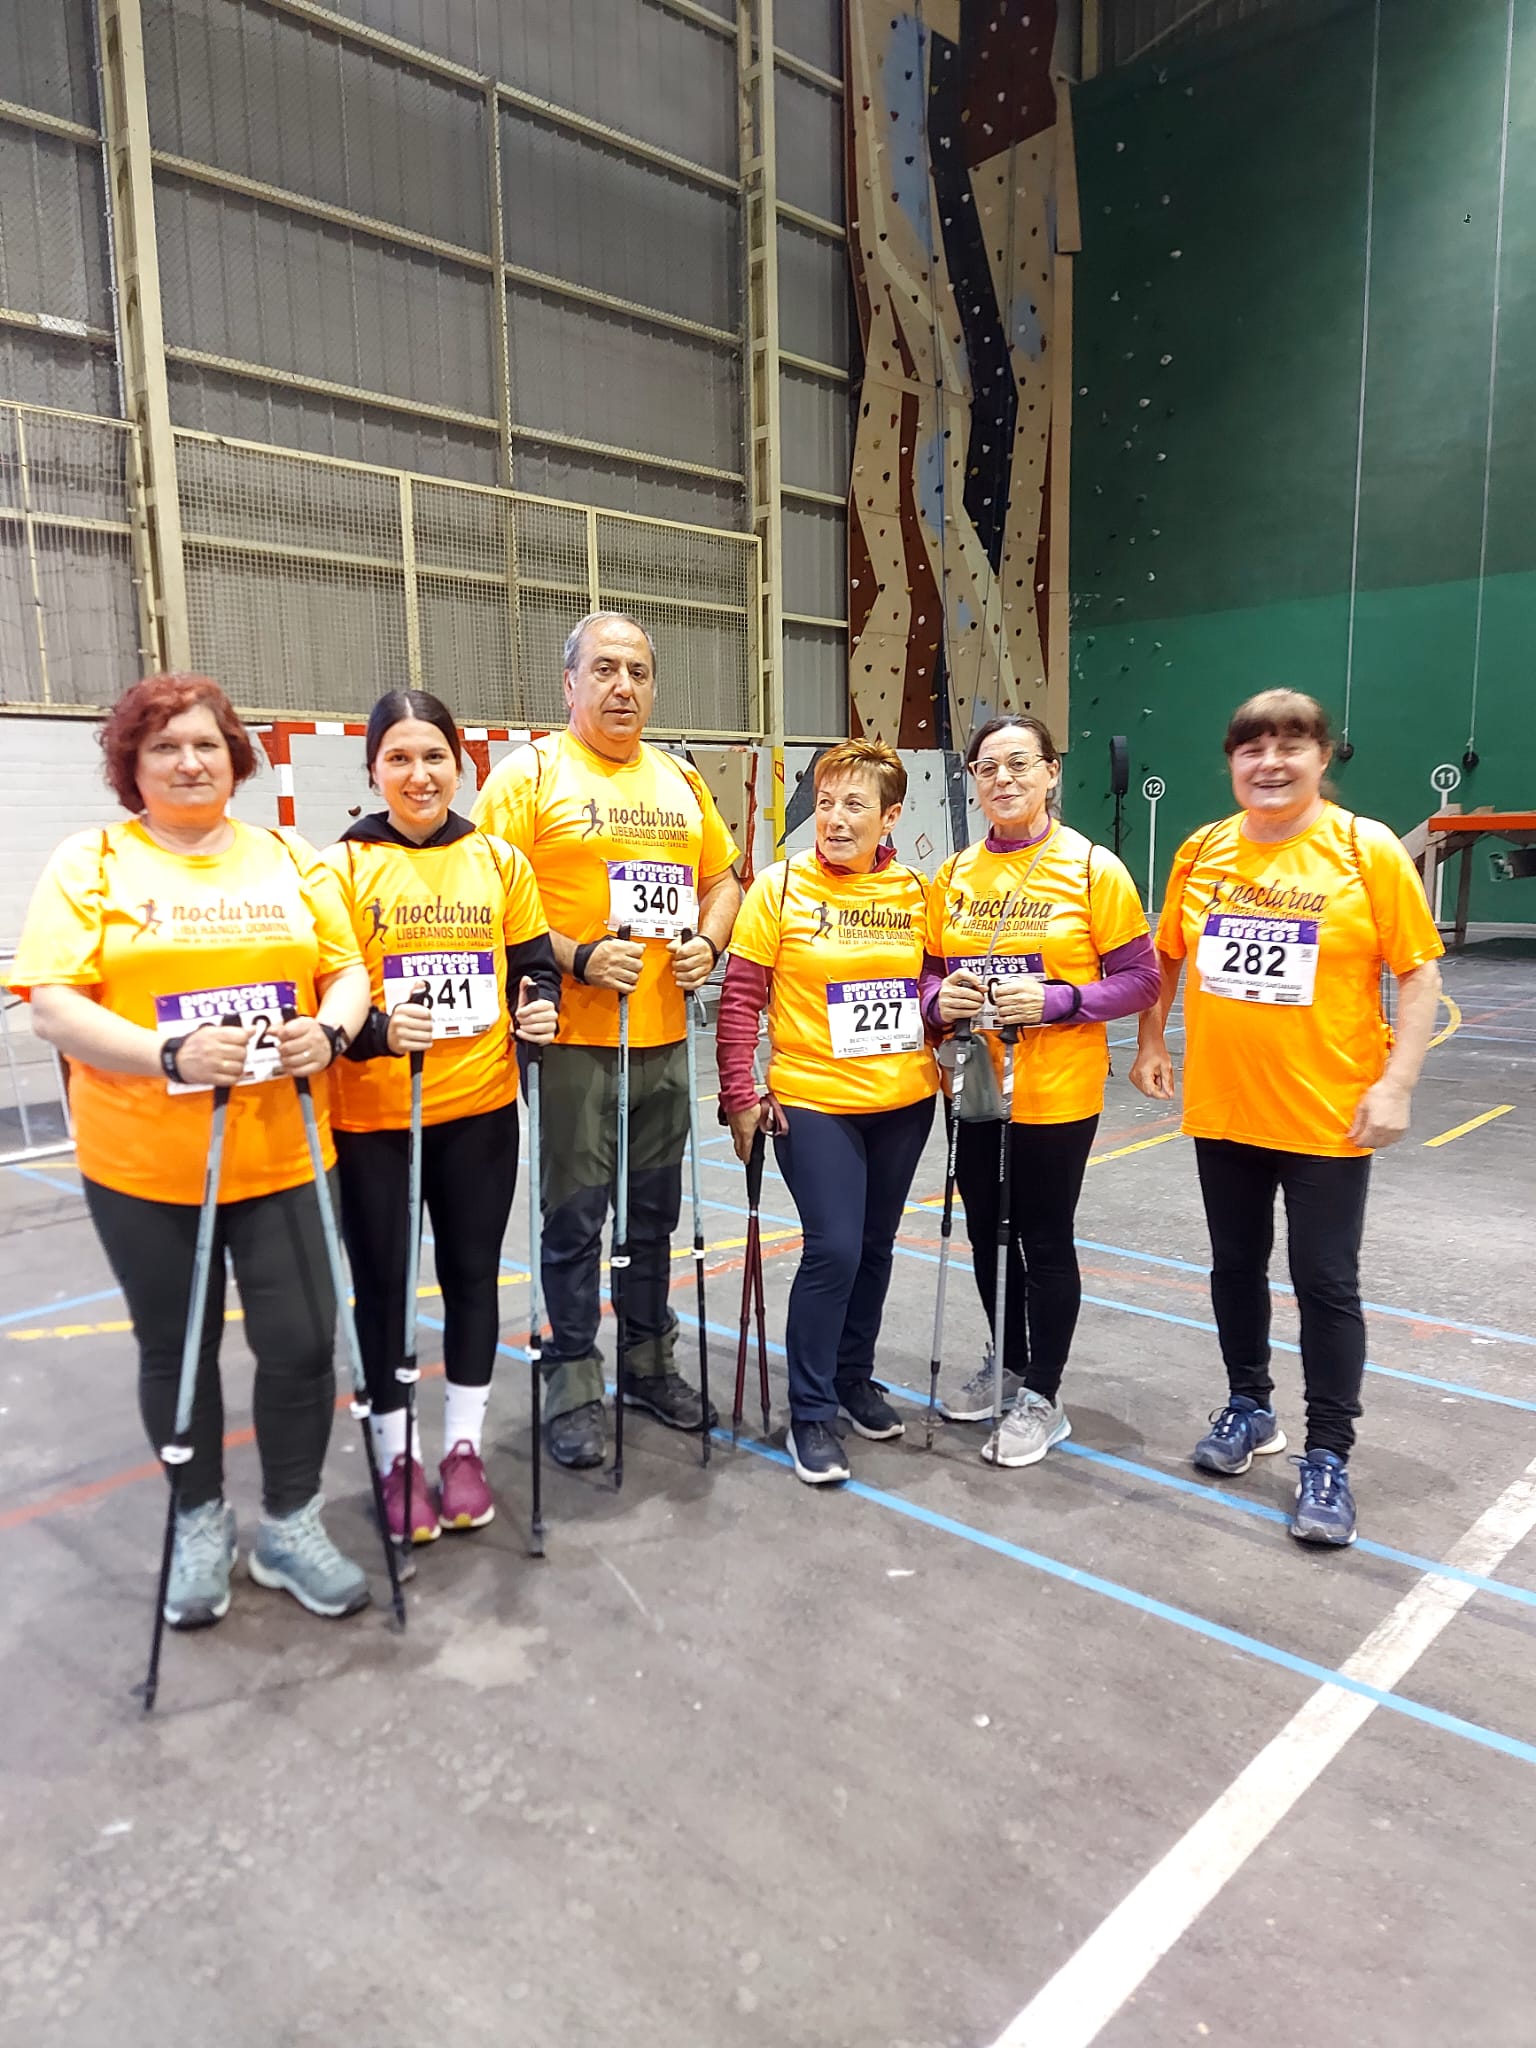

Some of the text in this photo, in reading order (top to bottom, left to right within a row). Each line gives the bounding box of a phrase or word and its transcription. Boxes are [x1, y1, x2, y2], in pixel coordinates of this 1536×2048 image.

[1436, 771, 1454, 786] 11
[1146, 782, 1161, 795] 12
[609, 801, 687, 828] nocturna
[610, 826, 689, 842] LIBERANOS DOMINE
[624, 863, 684, 876] DIPUTACIÓN
[624, 871, 685, 886] BURGOS
[633, 884, 679, 916] 340
[1228, 879, 1328, 912] nocturna
[172, 898, 285, 922] nocturna
[395, 895, 493, 925] nocturna
[968, 891, 1054, 919] nocturna
[838, 901, 912, 930] nocturna
[1013, 920, 1050, 931] DOMINE
[1219, 917, 1300, 932] DIPUTACIÓN
[396, 927, 494, 941] LIBERANOS DOMINE
[838, 928, 916, 942] LIBERANOS DOMINE
[1218, 926, 1300, 943] BURGOS
[401, 952, 479, 967] DIPUTACIÓN
[1222, 941, 1286, 977] 282
[402, 963, 480, 977] BURGOS
[966, 964, 1029, 975] URGOS
[842, 979, 905, 993] DIPUTACIÓN
[178, 984, 277, 1007] DIPUTACIÓN
[843, 989, 907, 1002] BURGOS
[180, 997, 280, 1019] BURGOS
[853, 1001, 902, 1033] 227
